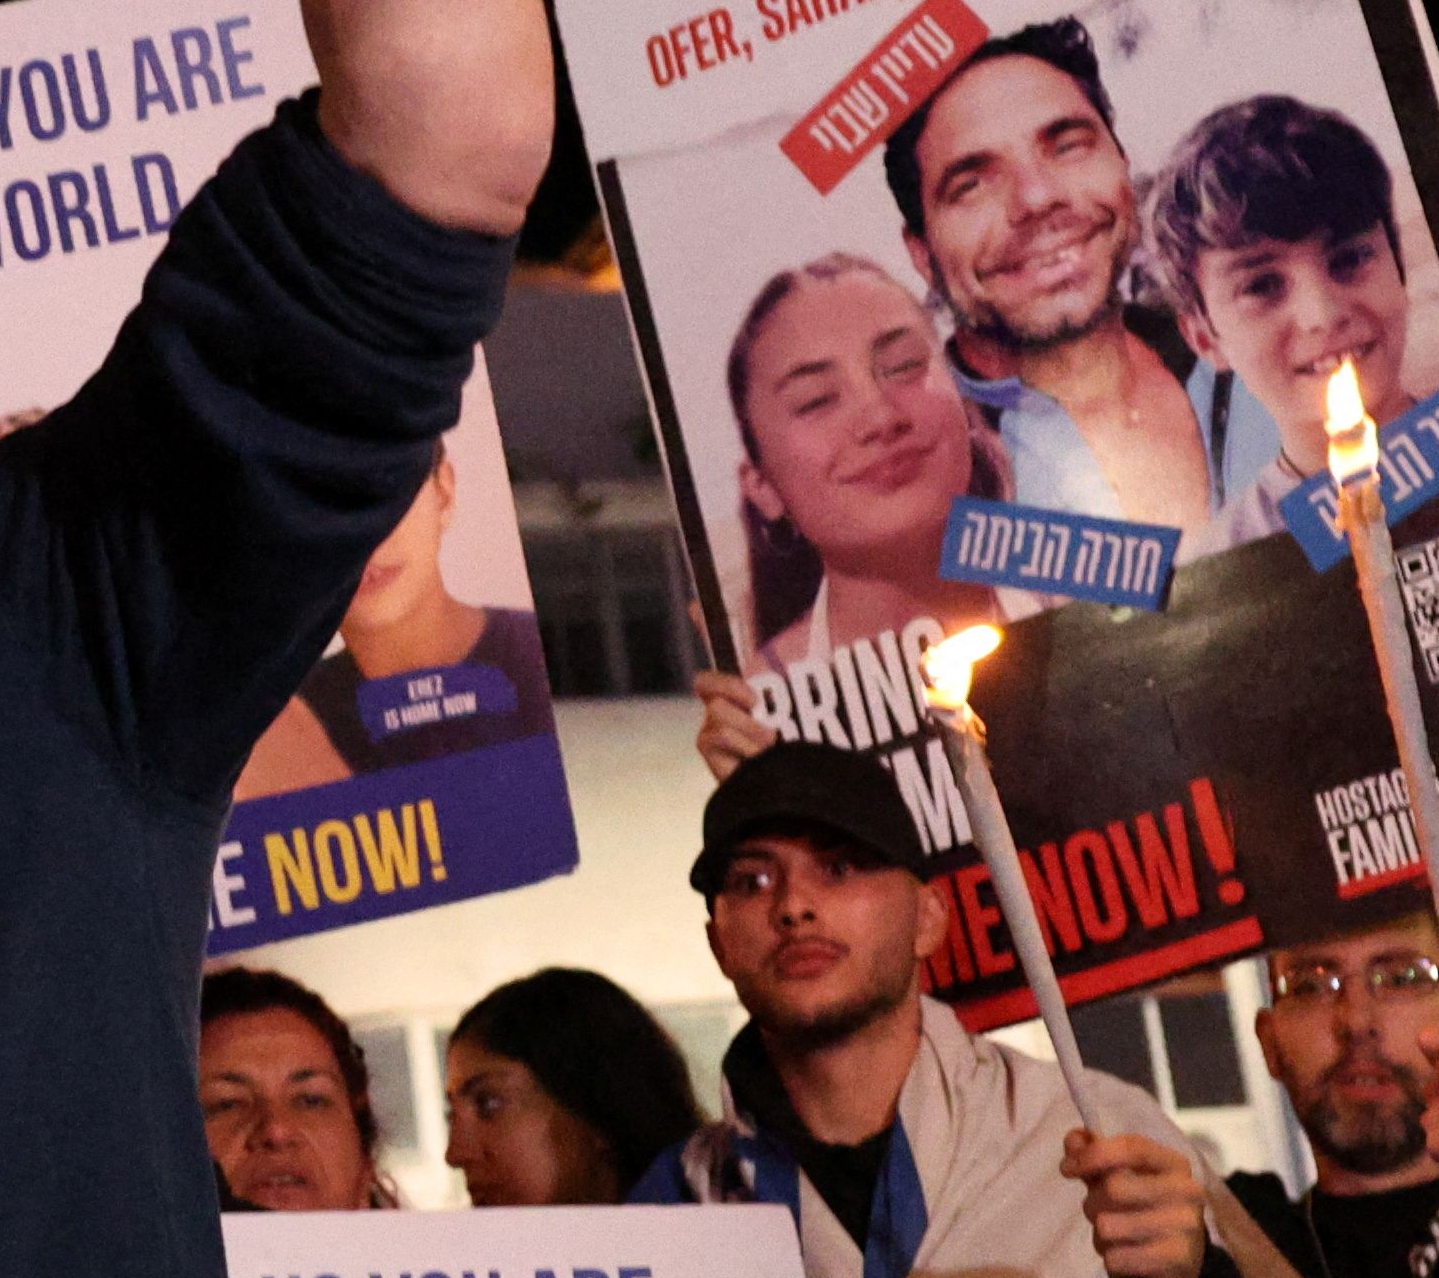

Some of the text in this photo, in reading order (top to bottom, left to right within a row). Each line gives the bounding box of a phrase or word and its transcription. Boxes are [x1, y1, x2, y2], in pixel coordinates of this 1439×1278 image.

[132, 16, 266, 123] ARE
[645, 7, 754, 90] OFER,
[956, 511, 1164, 597] חזרה הביתה
[263, 798, 448, 916] NOW!
[1017, 776, 1246, 954] NOW!
